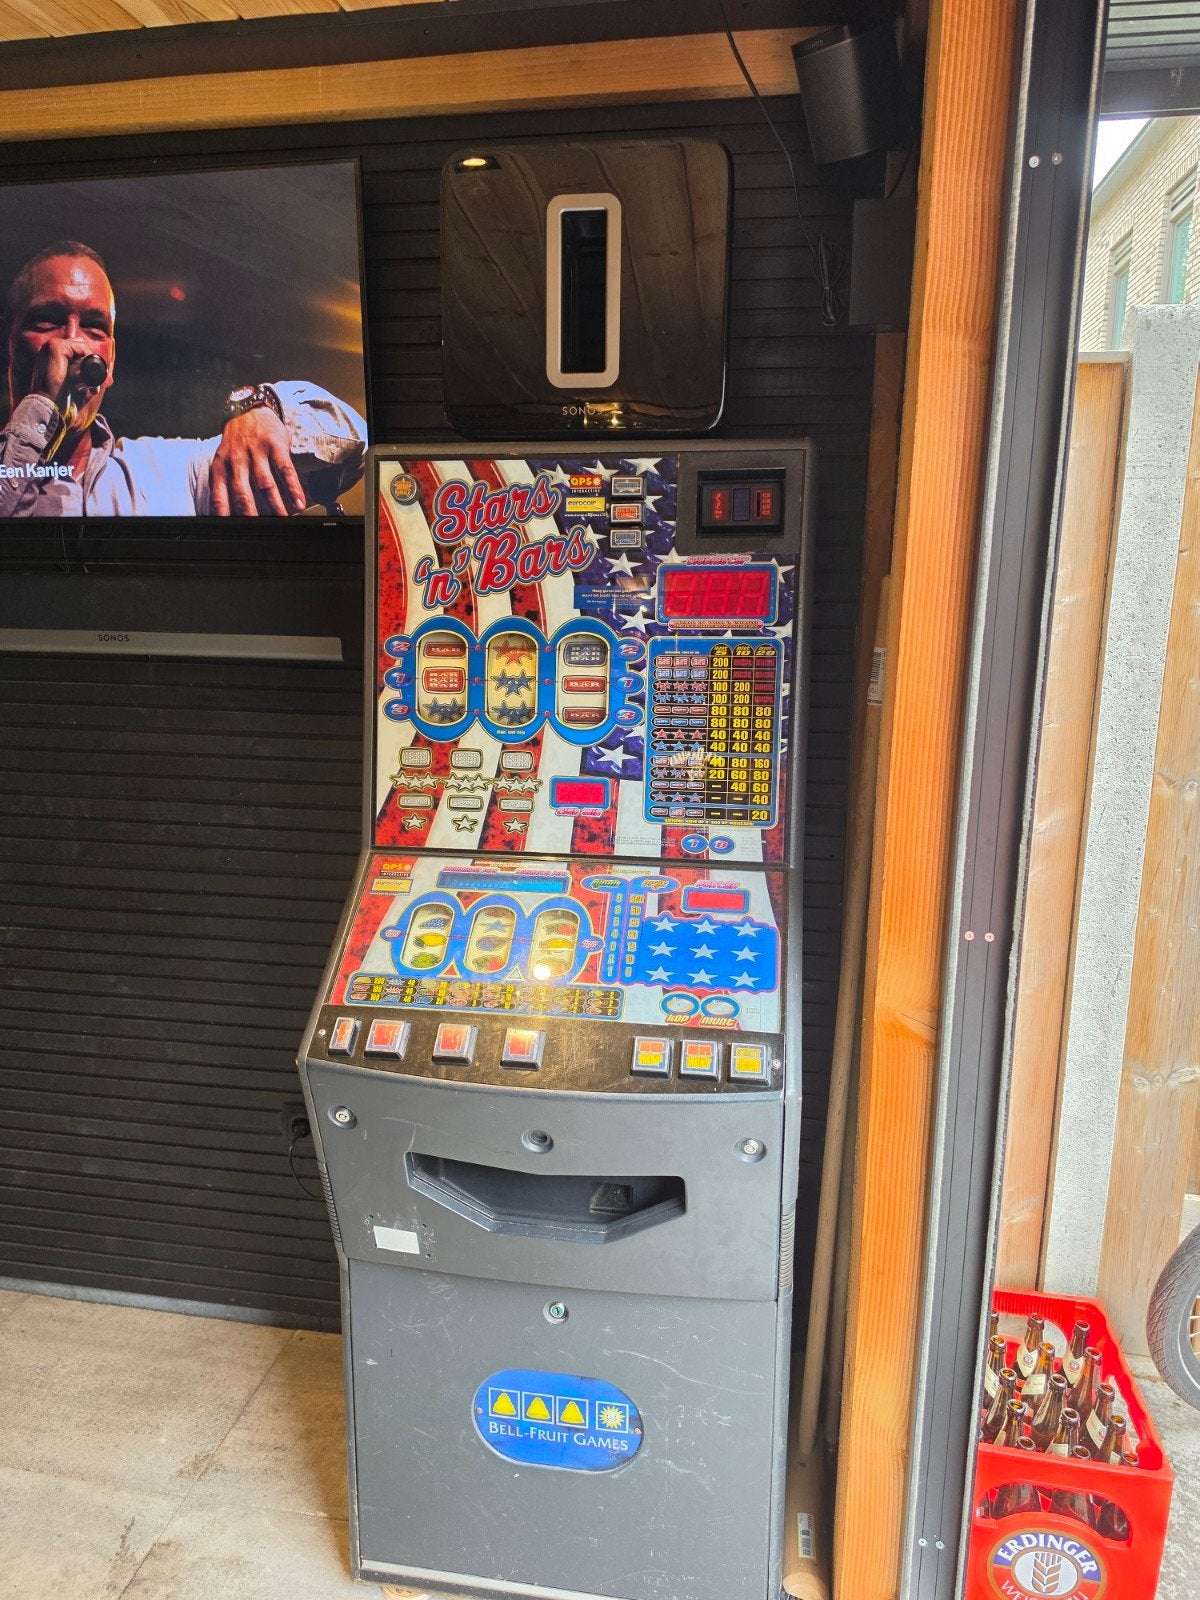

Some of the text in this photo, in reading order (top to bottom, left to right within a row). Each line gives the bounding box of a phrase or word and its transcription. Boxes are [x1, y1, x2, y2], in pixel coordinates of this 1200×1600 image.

[0, 461, 74, 480] Een Kanjer
[570, 477, 592, 486] QPS
[434, 475, 560, 543] Stars
[474, 528, 598, 595] Bars
[98, 634, 130, 642] SONOS
[621, 645, 639, 656] 2
[712, 658, 729, 668] 200
[712, 670, 728, 680] 200
[712, 682, 750, 692] 100 200
[712, 694, 750, 704] 100 200
[616, 711, 636, 720] 3
[711, 706, 772, 717] 80 80 80
[710, 718, 771, 729] 80 80 80
[710, 730, 770, 740] 40 40 40
[710, 742, 770, 753] 40 40 40
[709, 756, 770, 768] 40 80 160
[709, 770, 770, 780] 20 60 80
[730, 782, 769, 793] 40 60
[752, 794, 769, 805] 40
[752, 810, 768, 820] 20
[489, 1421, 629, 1450] BELL-FRUIT GAMES
[996, 1533, 1098, 1575] ERDINGER
